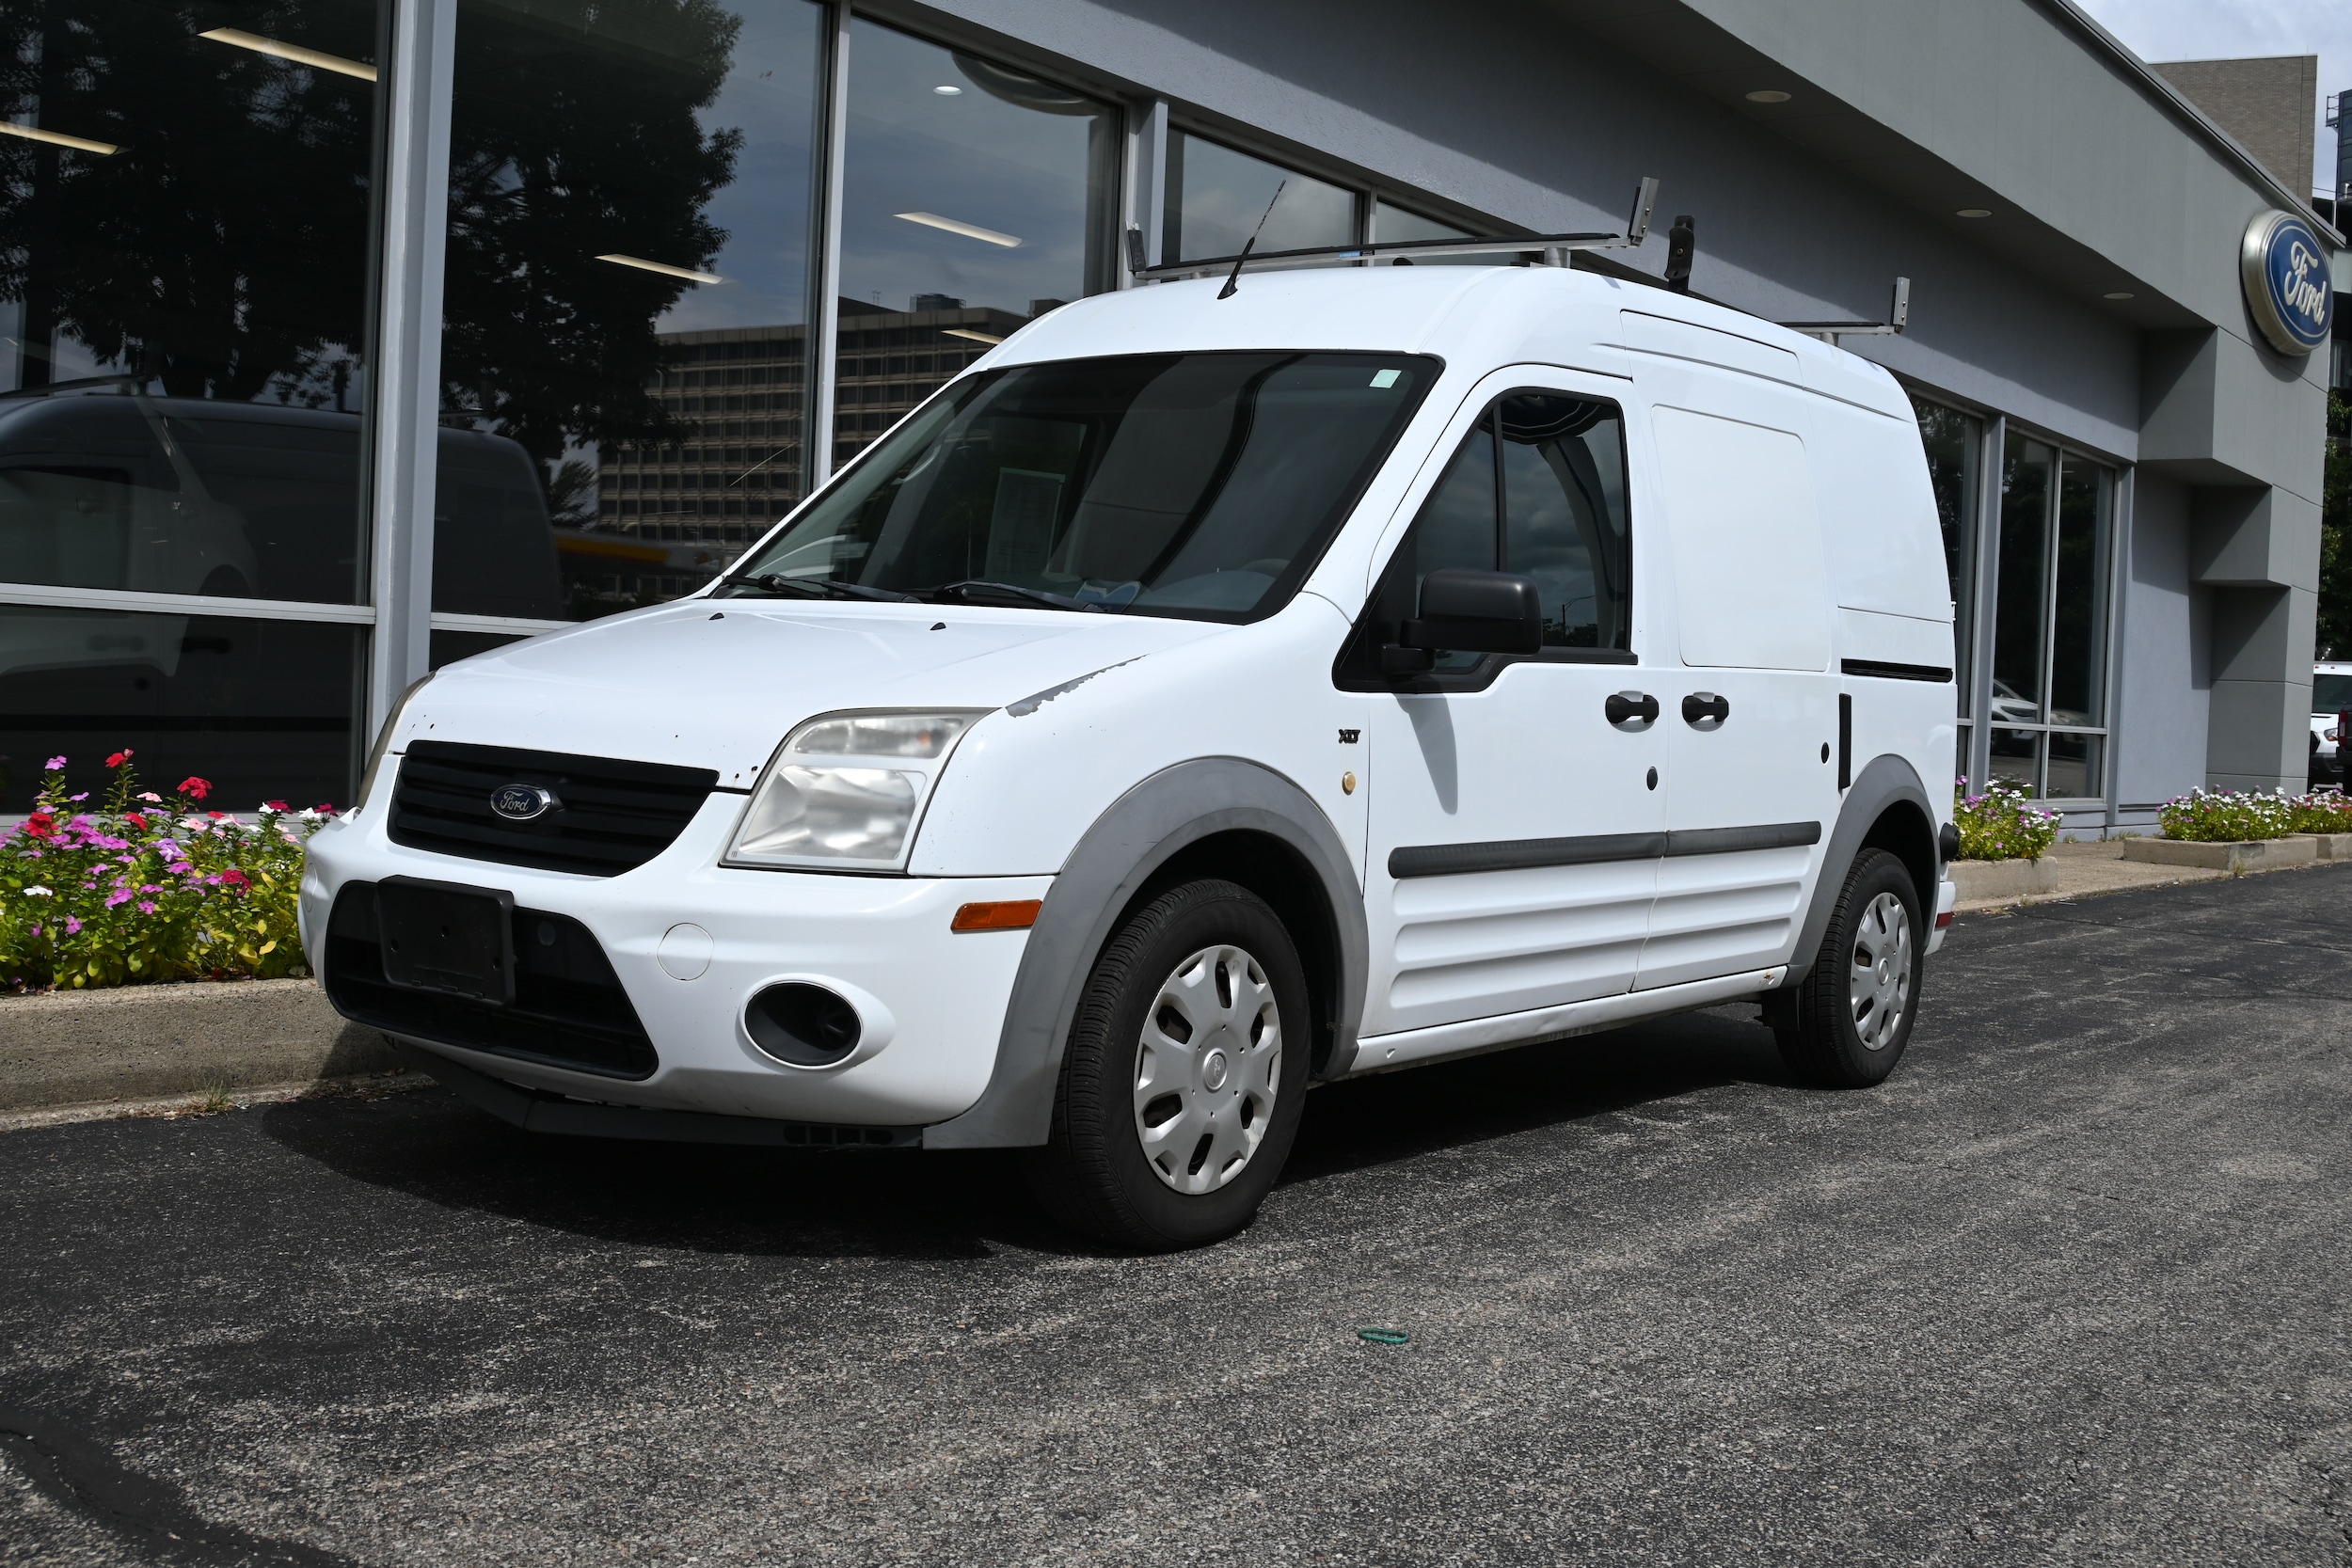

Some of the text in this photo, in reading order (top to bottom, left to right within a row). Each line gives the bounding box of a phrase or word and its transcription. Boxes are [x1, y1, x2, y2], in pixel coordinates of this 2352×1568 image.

[2284, 241, 2327, 326] Ford
[1338, 729, 1361, 744] XLT
[500, 790, 530, 812] Ford
